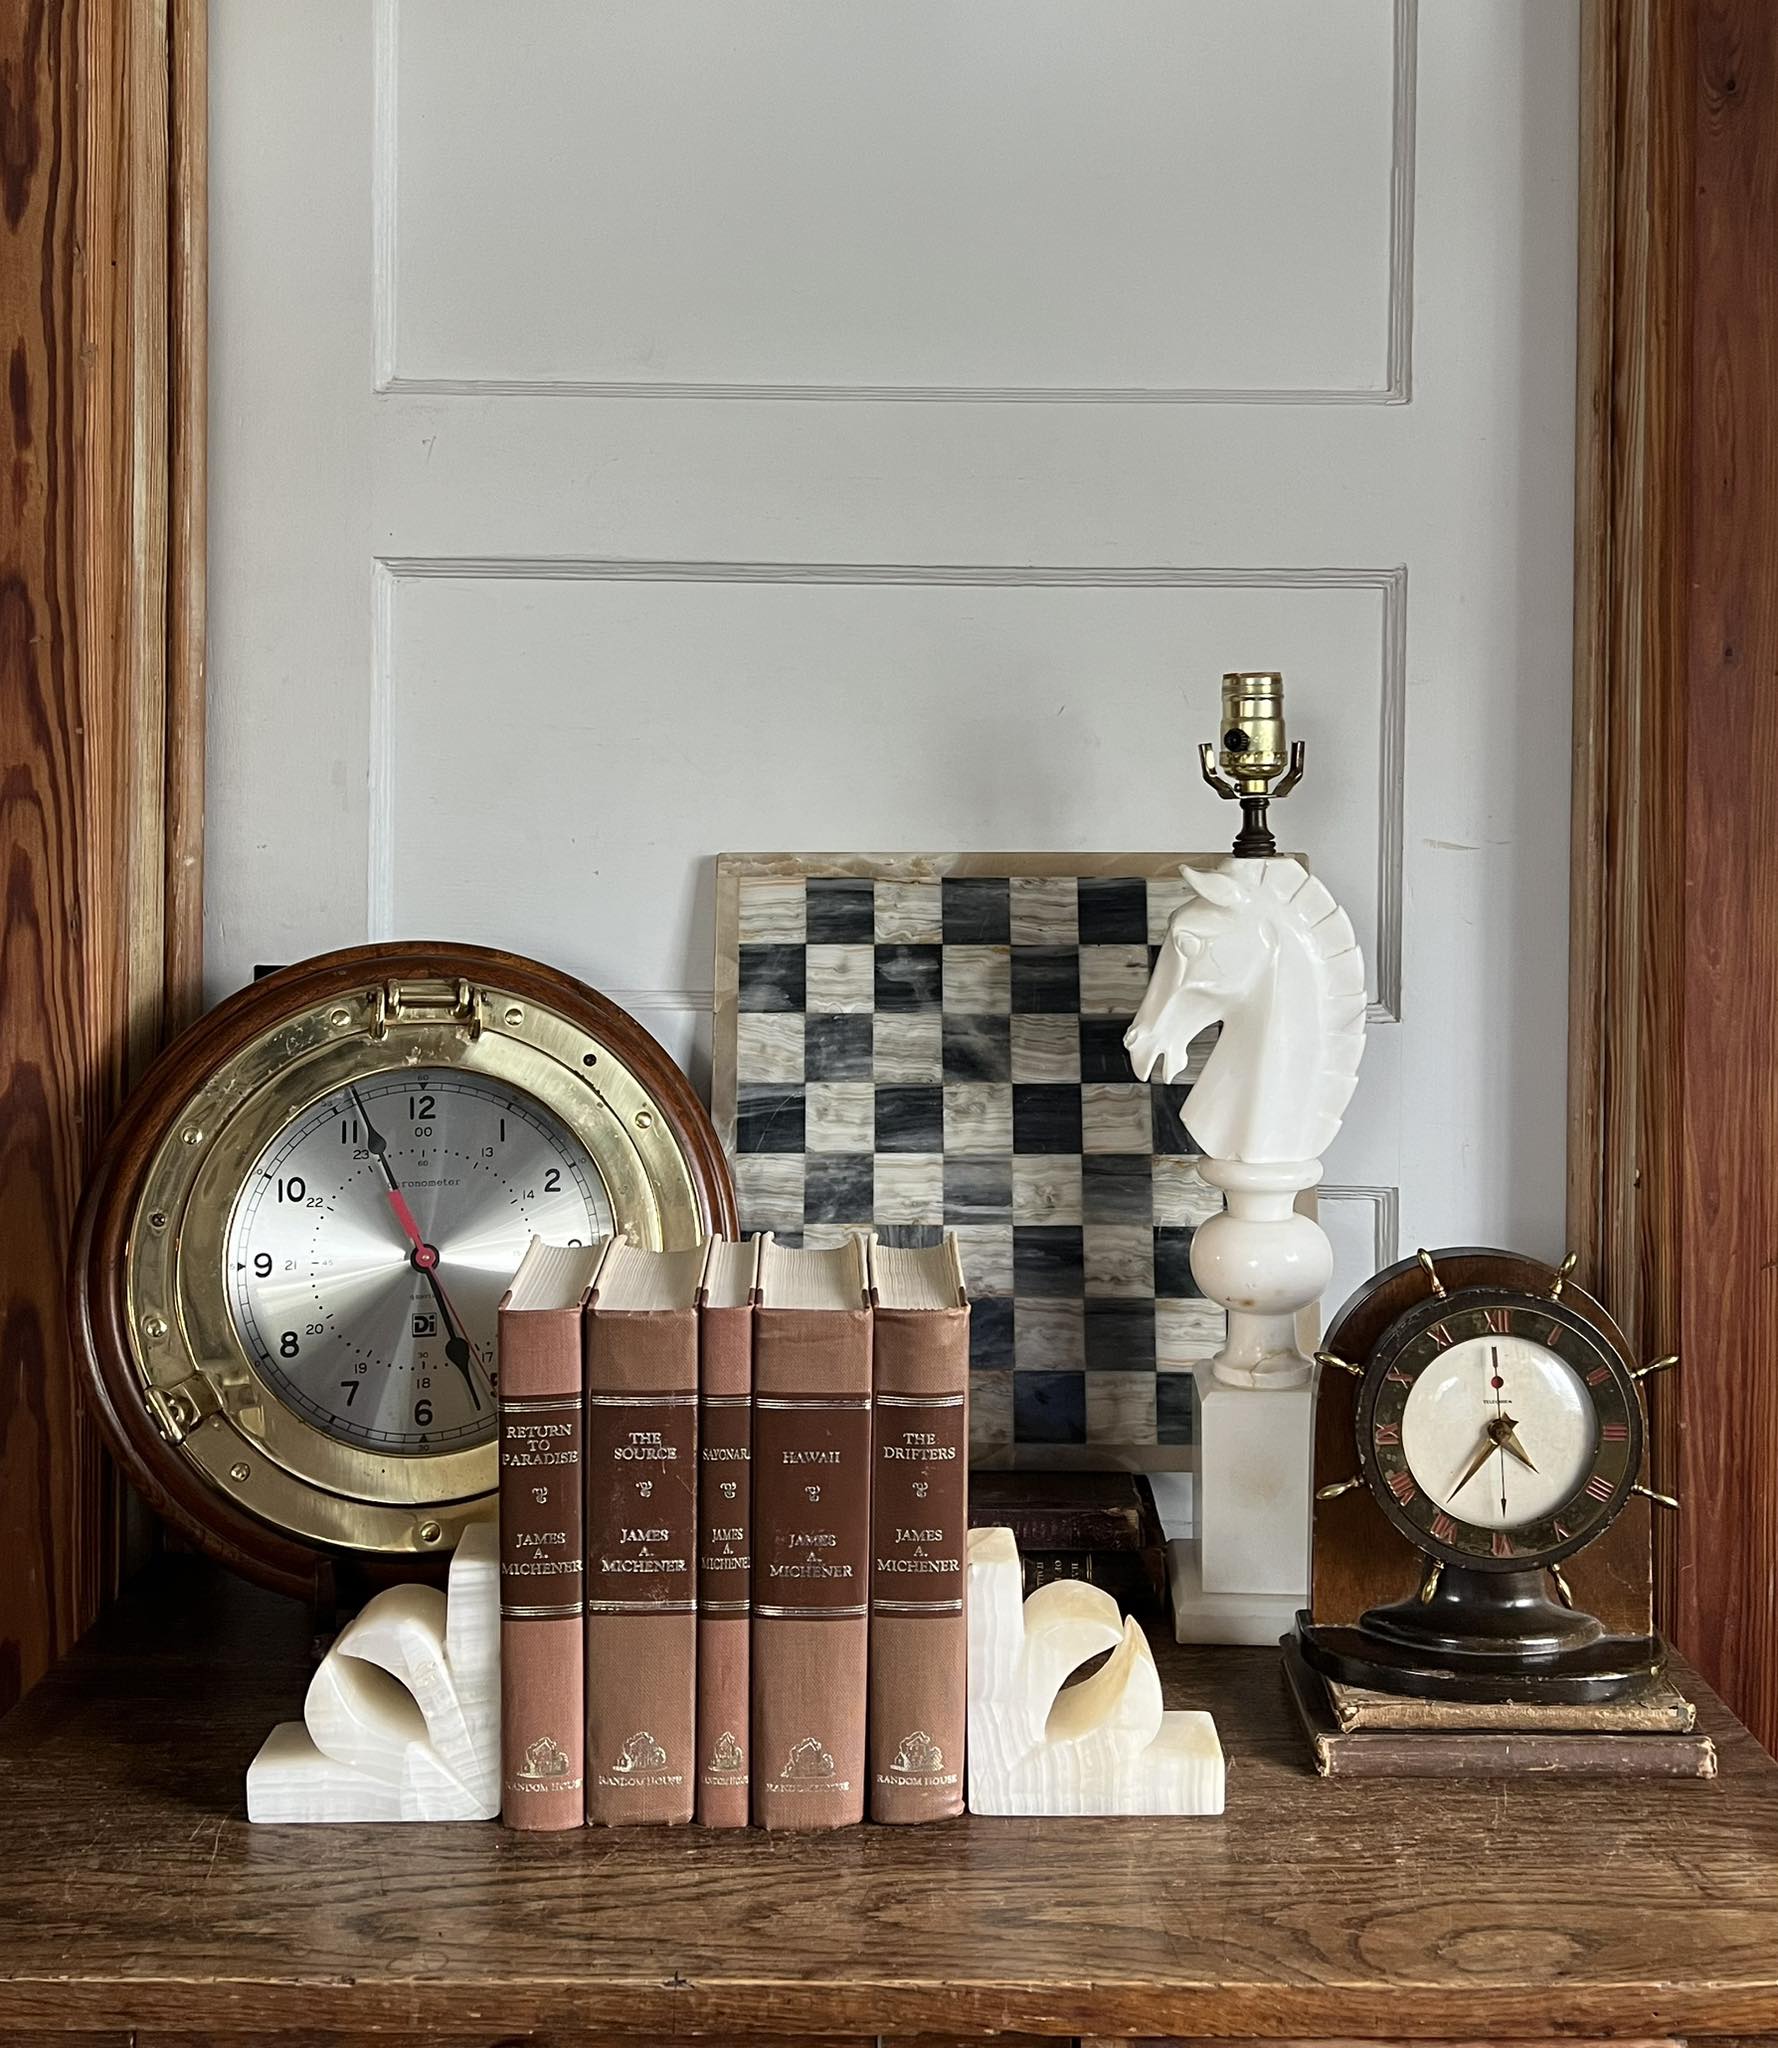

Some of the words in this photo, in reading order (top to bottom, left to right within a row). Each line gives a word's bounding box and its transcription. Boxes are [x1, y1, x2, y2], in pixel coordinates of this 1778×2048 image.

[410, 1095, 436, 1120] 12
[341, 1120, 358, 1145] 11
[414, 1127, 433, 1137] 00
[500, 1118, 505, 1142] 1
[353, 1149, 370, 1160] 23
[481, 1147, 494, 1158] 13
[388, 1178, 461, 1190] ronometer
[544, 1168, 561, 1192] 2
[278, 1176, 306, 1203] 10
[523, 1189, 535, 1200] 14
[306, 1197, 324, 1208] 22
[254, 1252, 272, 1278] 9
[285, 1259, 297, 1271] 21
[414, 1314, 435, 1333] Di
[1484, 1310, 1512, 1333] XII
[306, 1323, 324, 1335] 20
[280, 1331, 300, 1358] 8
[482, 1351, 493, 1363] 17
[354, 1362, 368, 1374] 19
[416, 1377, 431, 1389] 18
[340, 1380, 360, 1407] 7
[414, 1399, 433, 1426] 6
[506, 1424, 572, 1439] RETURN
[628, 1432, 662, 1445] THE
[903, 1432, 936, 1445] THE
[527, 1439, 550, 1452] TO
[502, 1450, 579, 1467] PARADISE
[614, 1447, 678, 1461] SOURCE
[783, 1451, 841, 1463] HAWAII
[883, 1446, 956, 1461] DRIFTERS
[516, 1532, 566, 1548] JAMES
[620, 1528, 669, 1544] JAMES
[711, 1528, 744, 1543] JAMES
[789, 1534, 837, 1548] JAMES
[895, 1529, 943, 1544] JAMES
[533, 1548, 549, 1559] A.
[638, 1546, 654, 1557] A.
[722, 1543, 734, 1555] A.
[913, 1545, 928, 1557] A.
[701, 1557, 750, 1571] MICHENE
[806, 1551, 823, 1563] A.
[501, 1559, 583, 1576] MICHENER
[601, 1559, 687, 1573] MICHENER
[769, 1564, 854, 1578] MICHENER
[877, 1558, 960, 1573] MICHENER
[876, 1774, 922, 1786] RANDOM
[924, 1773, 958, 1785] HOUSE
